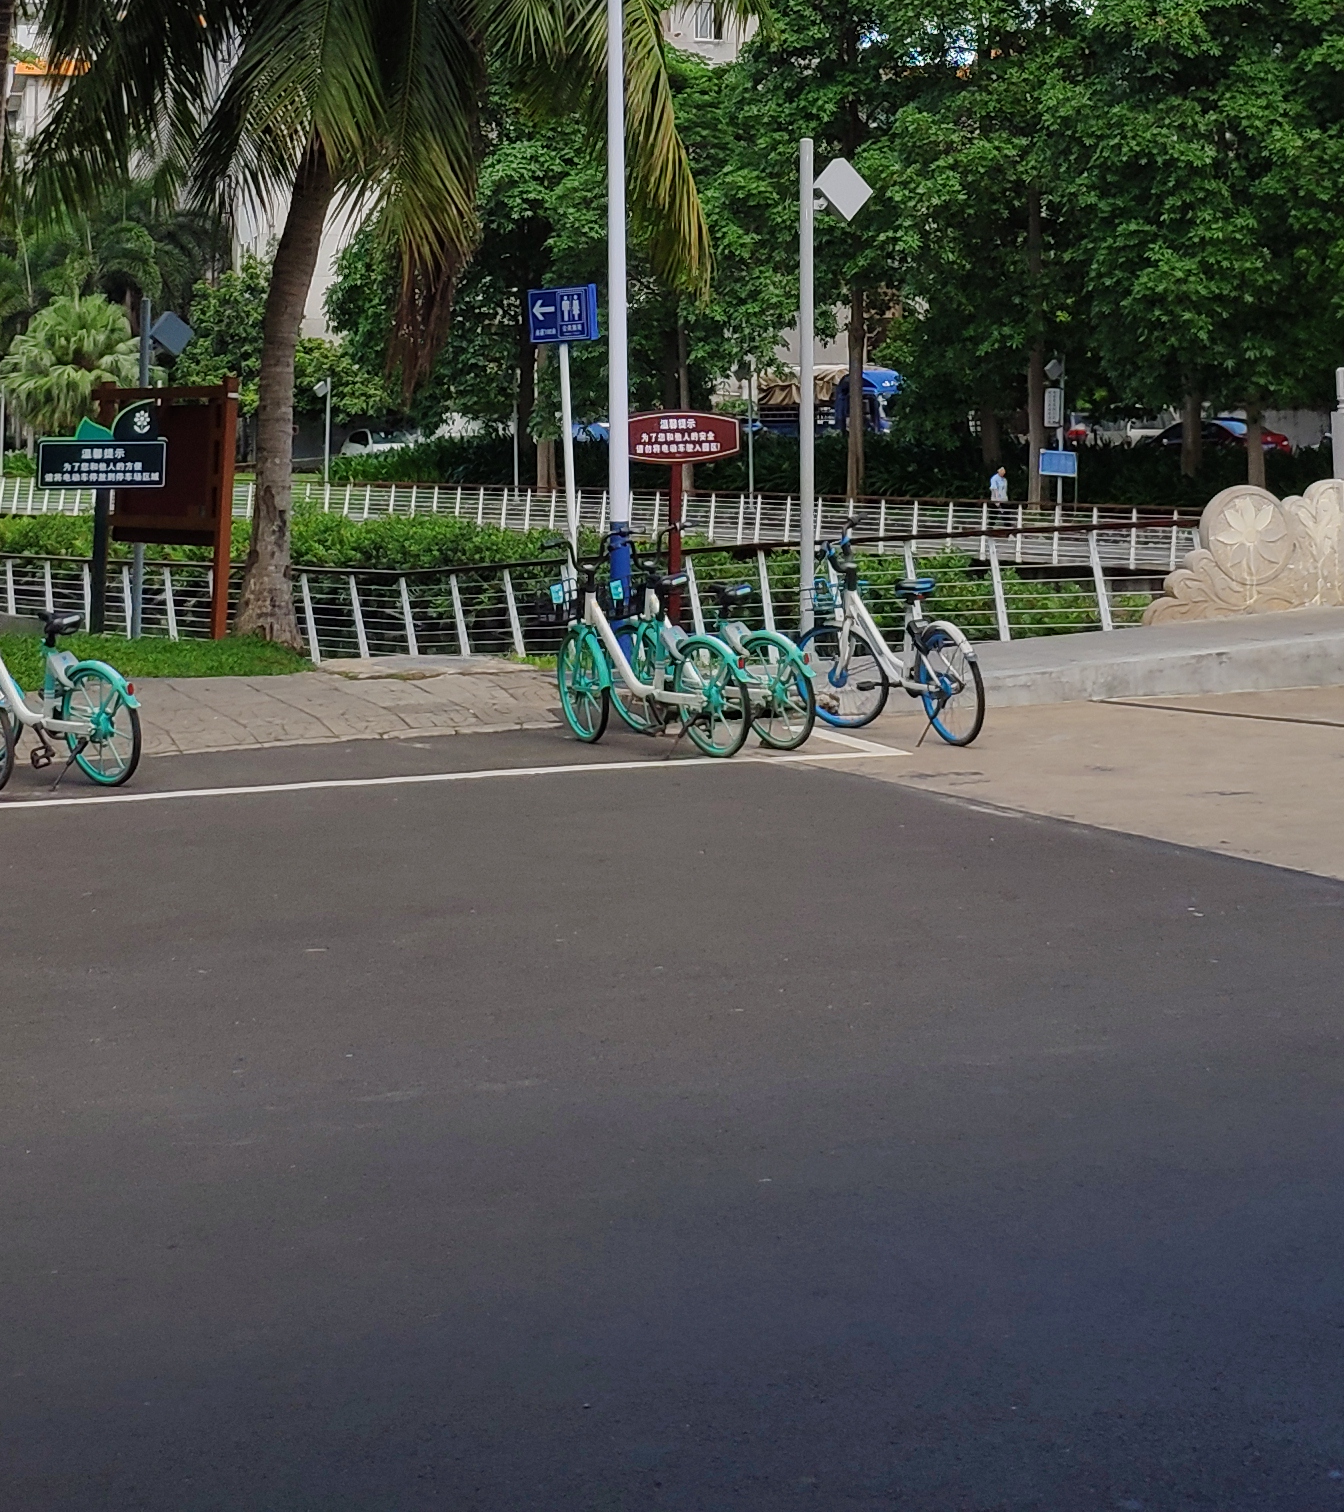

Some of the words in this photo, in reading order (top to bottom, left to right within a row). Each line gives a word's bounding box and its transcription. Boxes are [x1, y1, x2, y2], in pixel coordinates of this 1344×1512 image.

[659, 418, 696, 430] 温馨提示
[640, 431, 715, 443] 为了您和他人的安全
[81, 448, 126, 459] 温馨提示
[63, 461, 143, 472] 为了您和他人的方便
[44, 471, 160, 482] 请将电动车停放到停车场区域
